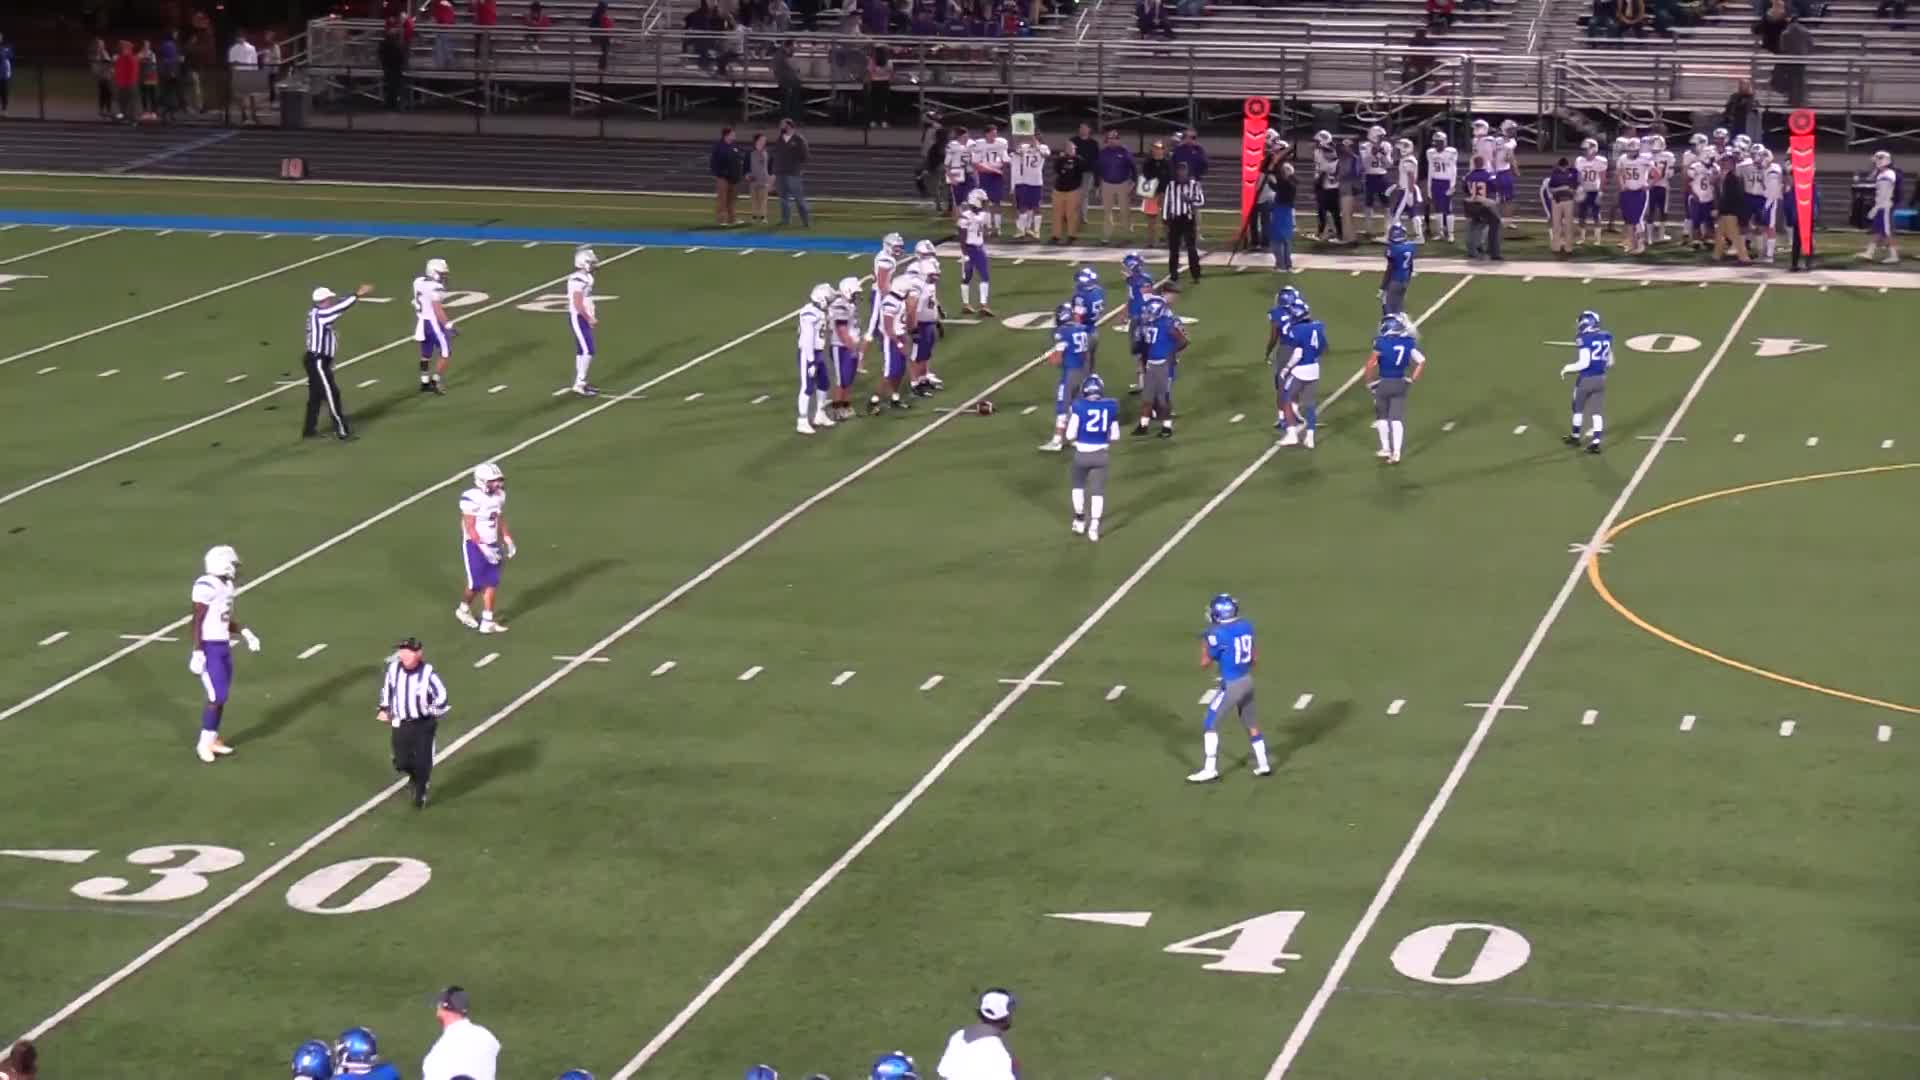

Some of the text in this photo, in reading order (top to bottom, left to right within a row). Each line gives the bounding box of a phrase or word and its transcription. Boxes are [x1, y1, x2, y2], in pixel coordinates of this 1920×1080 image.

[1310, 329, 1319, 349] 4
[1393, 345, 1406, 366] 7
[1591, 340, 1611, 360] 22
[1086, 409, 1109, 432] 21
[1234, 634, 1252, 665] 19
